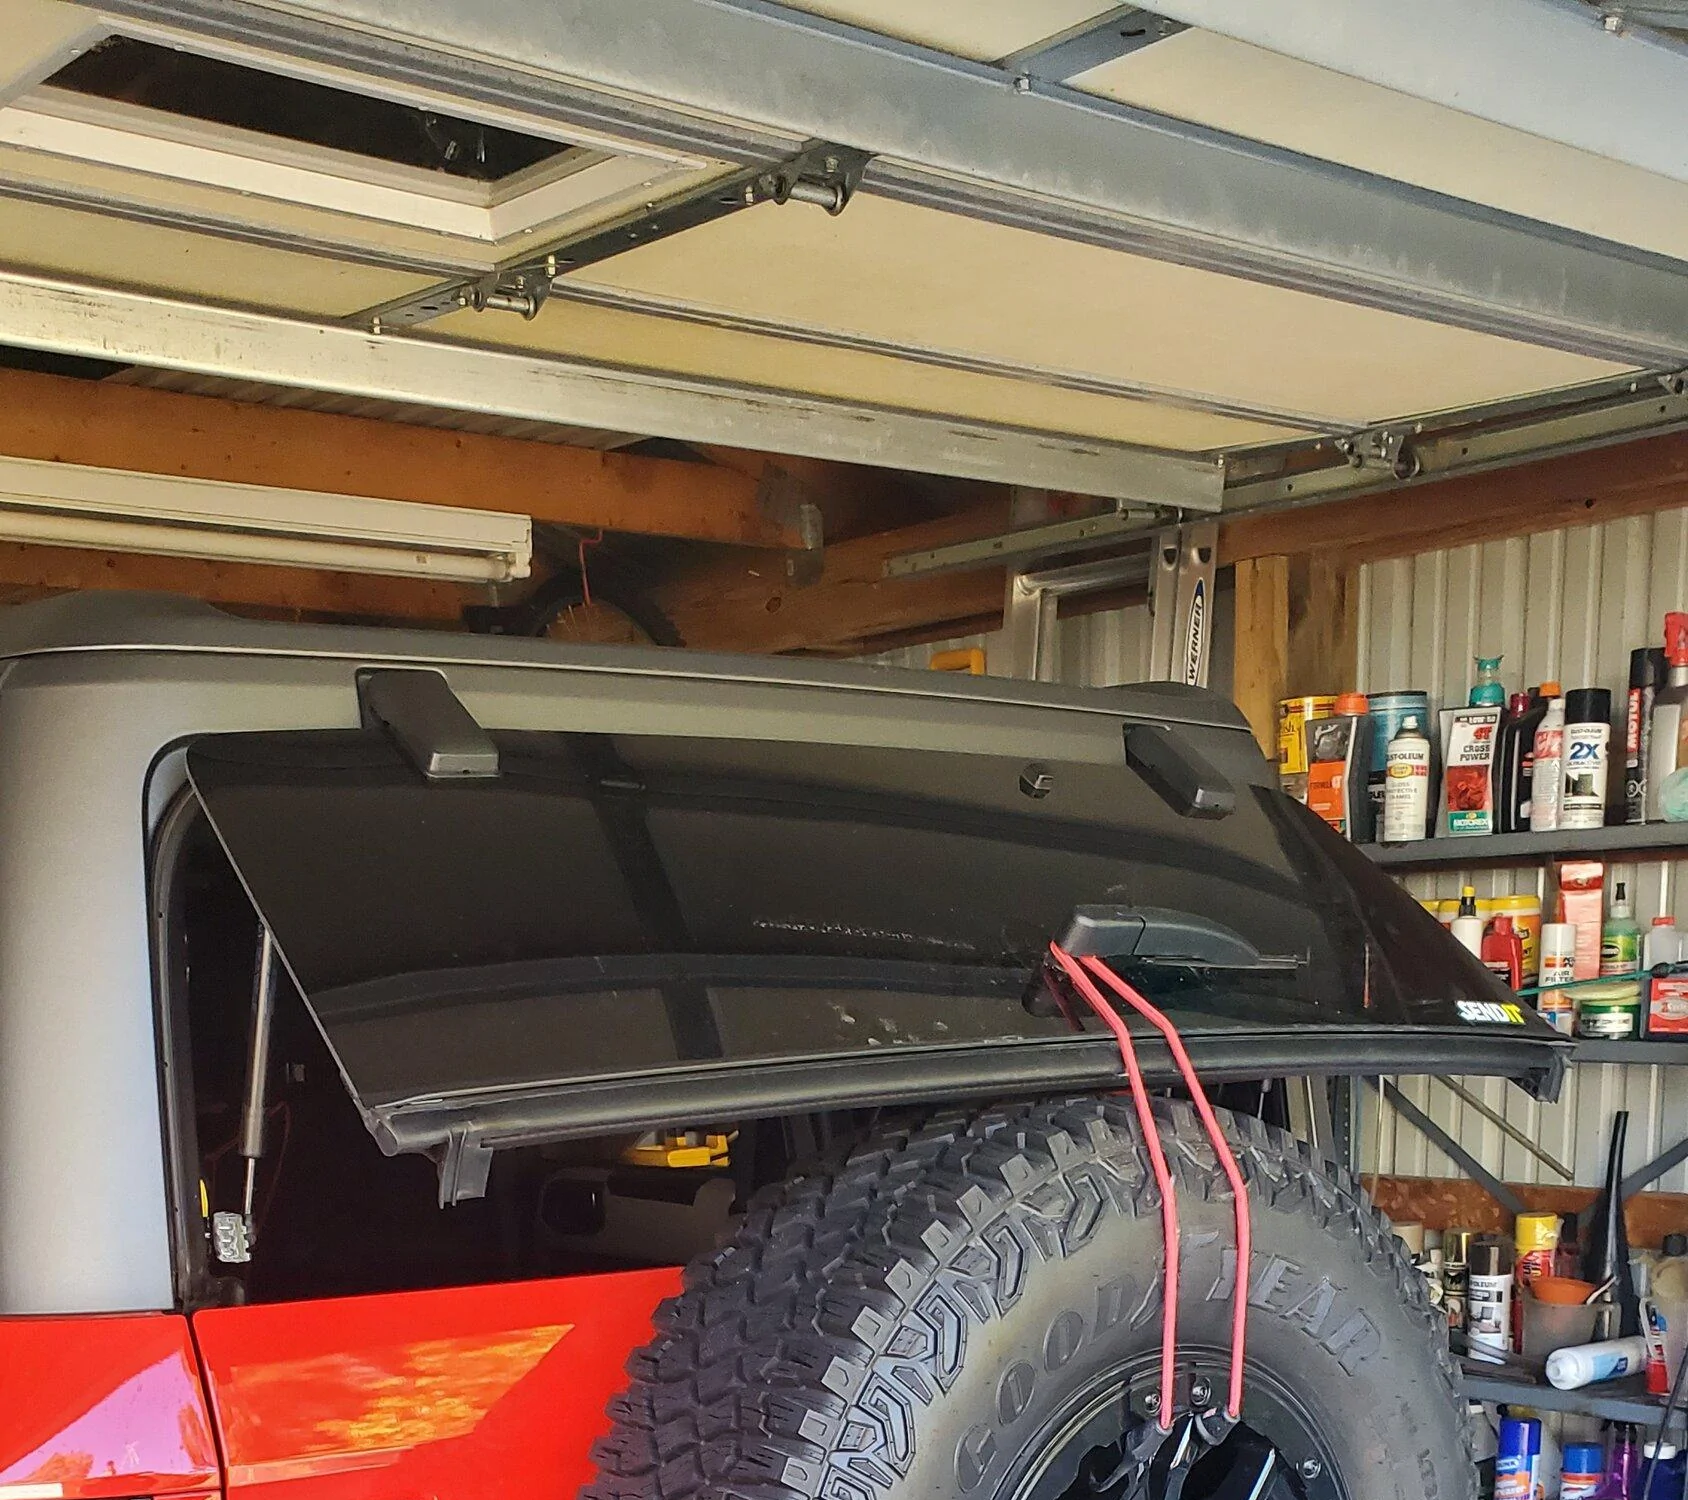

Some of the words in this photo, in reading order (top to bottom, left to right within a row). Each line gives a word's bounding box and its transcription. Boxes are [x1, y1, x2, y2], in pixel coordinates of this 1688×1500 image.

[1188, 602, 1203, 681] WERNER
[1627, 691, 1640, 748] MOTUL
[1459, 753, 1491, 762] POWER
[1463, 744, 1491, 753] CROSS
[1569, 741, 1600, 760] 2X
